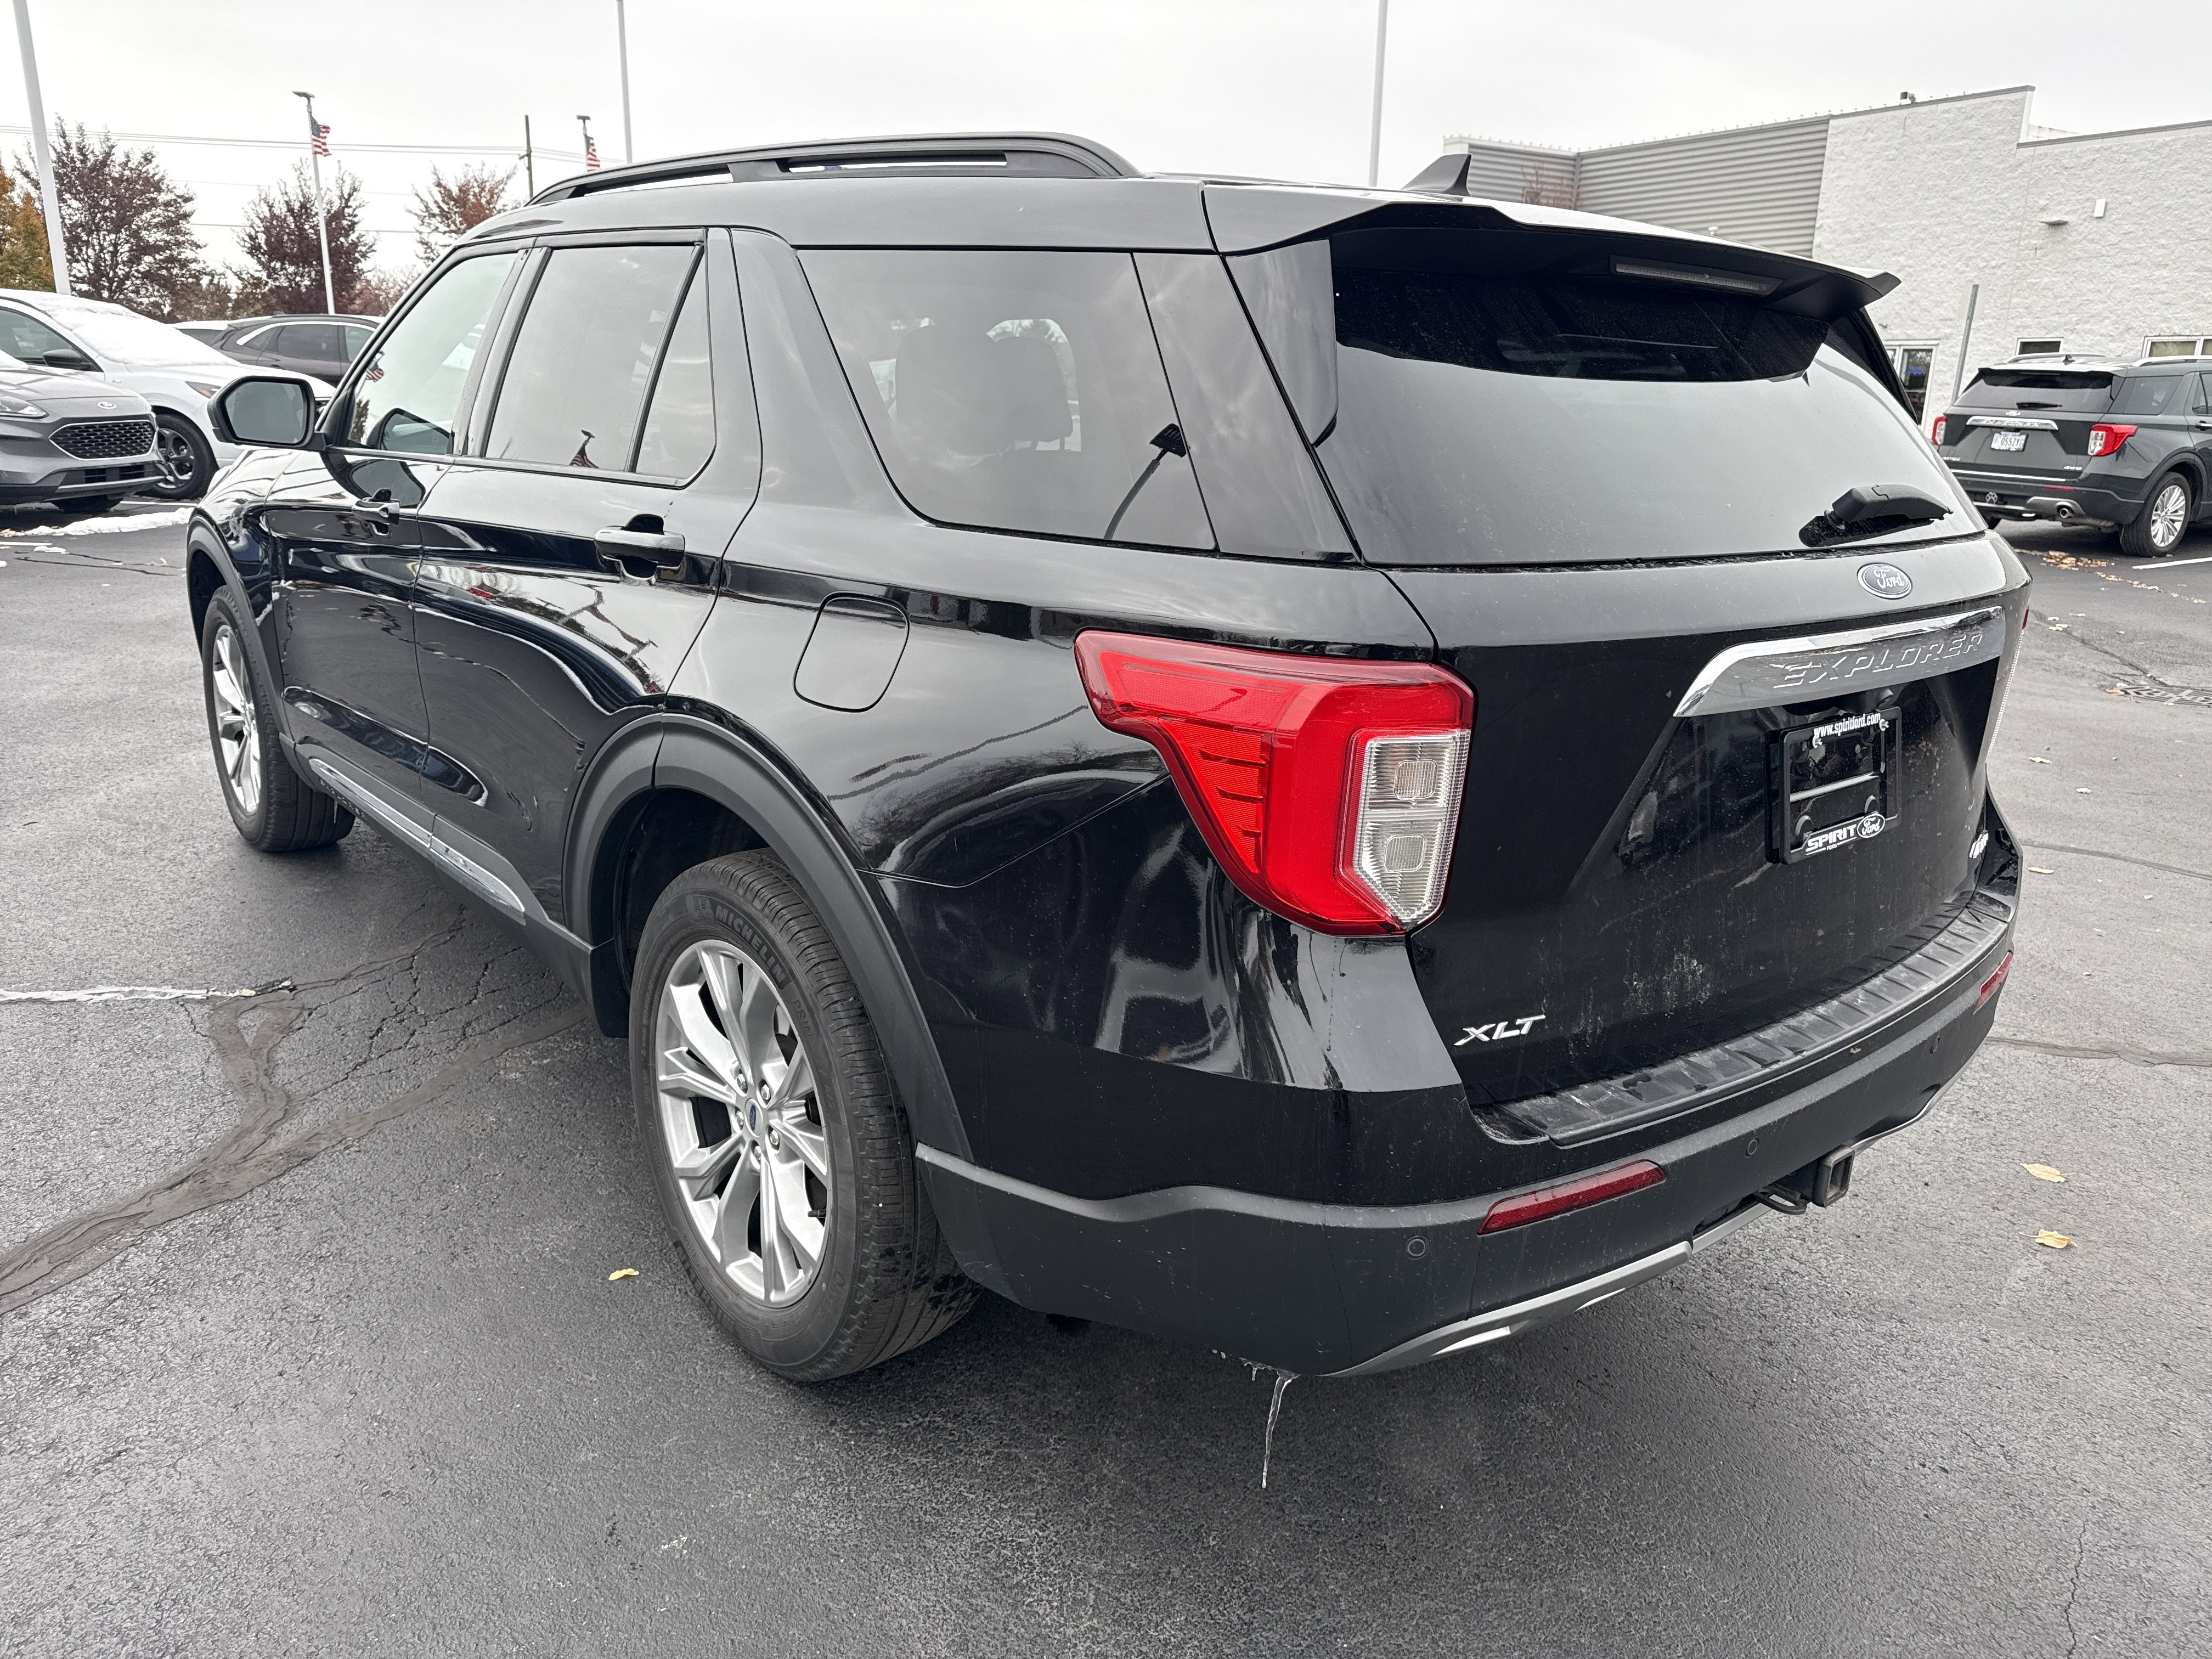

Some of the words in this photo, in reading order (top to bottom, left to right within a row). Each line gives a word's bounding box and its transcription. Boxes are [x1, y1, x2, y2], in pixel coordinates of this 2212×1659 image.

[1874, 568, 1904, 589] Ford
[1773, 631, 1983, 689] EXPLORER
[1813, 713, 1881, 738] www.spiritford.com
[1805, 824, 1857, 852] SPIRIT
[1861, 816, 1881, 836] Ford
[715, 905, 786, 984] MICHELIN
[1453, 1014, 1546, 1046] XLT
